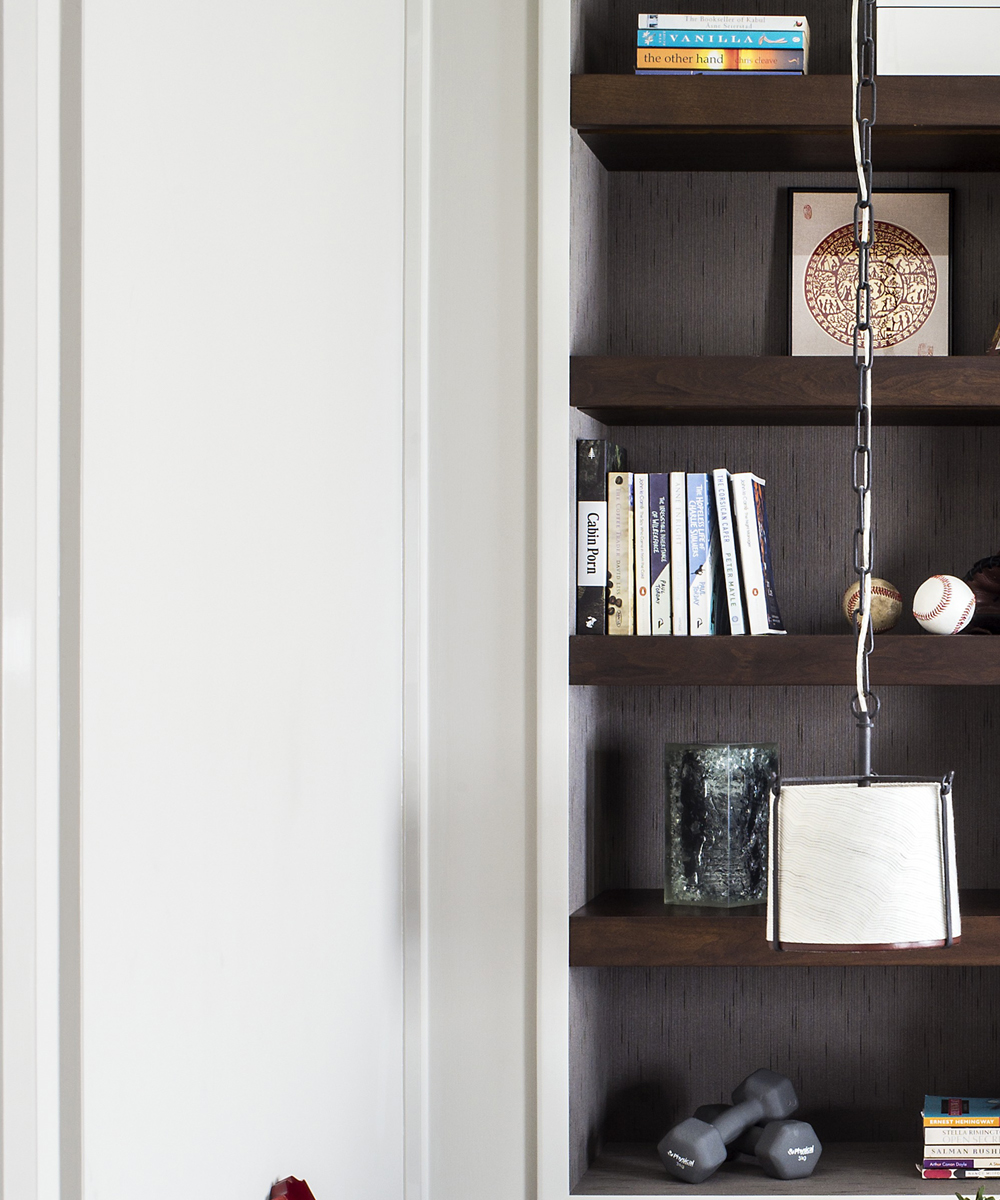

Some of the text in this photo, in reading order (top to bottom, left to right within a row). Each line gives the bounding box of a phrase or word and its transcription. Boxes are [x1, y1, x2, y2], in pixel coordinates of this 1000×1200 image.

[670, 34, 754, 43] VANILLA
[644, 54, 723, 64] the other hand
[689, 500, 697, 528] CHARLIE
[696, 496, 704, 527] HOPELESS
[718, 488, 727, 520] CORSICAN
[586, 512, 600, 574] Cabin Porn
[722, 522, 730, 542] CAPER
